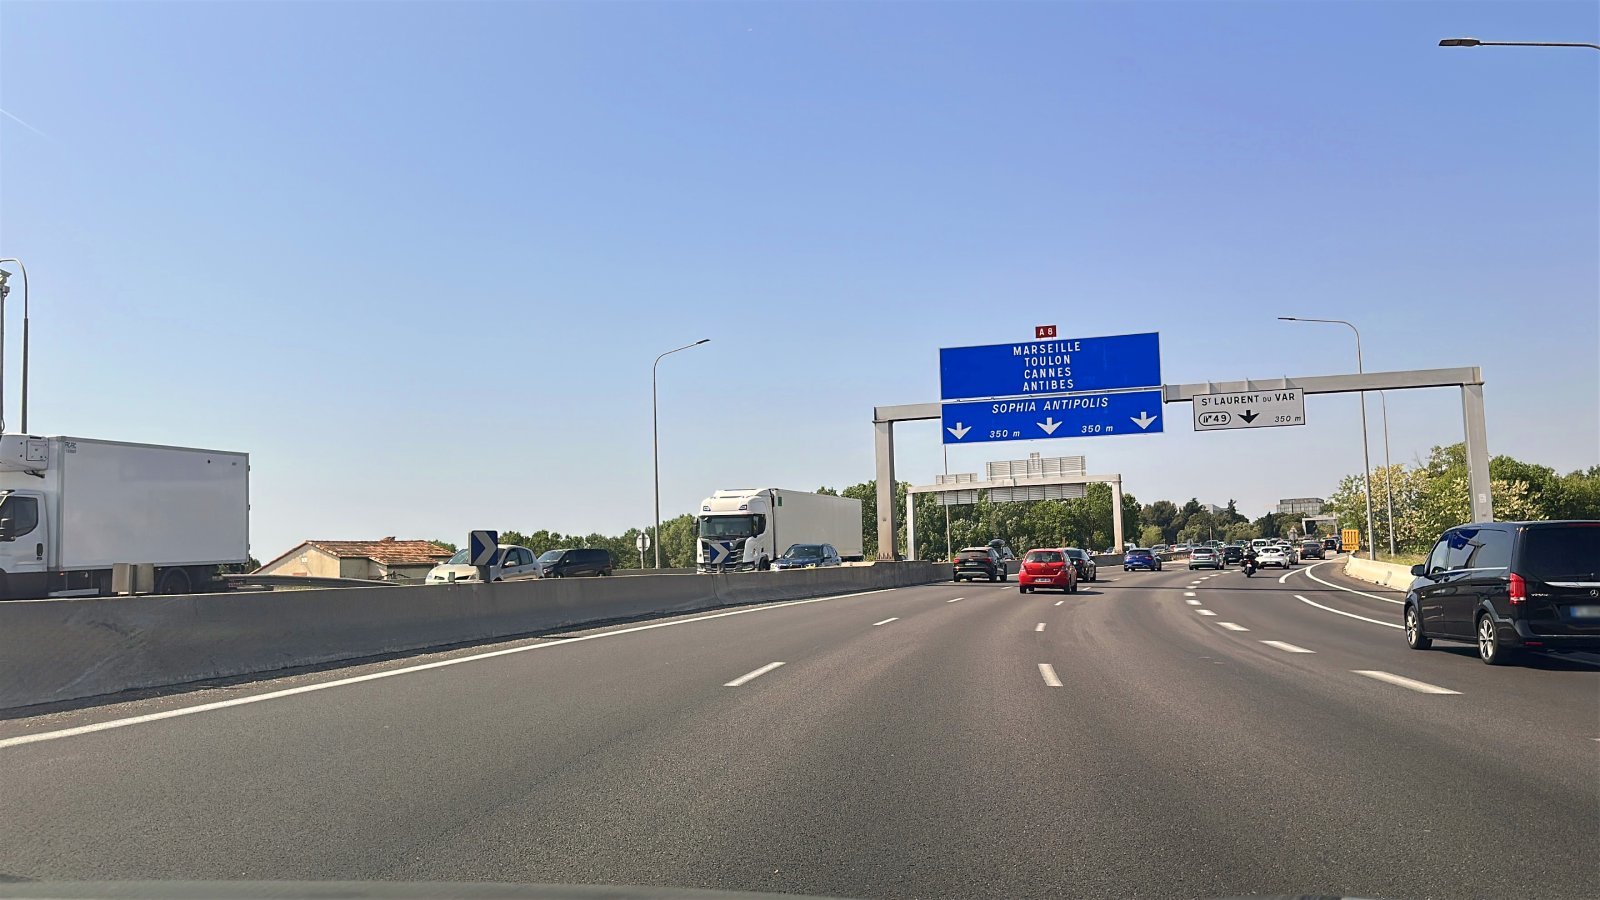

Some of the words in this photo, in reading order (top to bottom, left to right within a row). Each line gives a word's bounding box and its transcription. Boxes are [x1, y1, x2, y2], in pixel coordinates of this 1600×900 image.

[1013, 341, 1081, 356] MARSEILLE
[1024, 355, 1071, 367] TOULON
[1024, 367, 1071, 379] CANNES
[1023, 379, 1074, 391] ANTIBES
[1214, 395, 1259, 405] LAURENT
[1274, 392, 1295, 402] VAR
[992, 401, 1036, 414] SOPHIA
[1043, 397, 1109, 410] ANTIPOLIS
[1274, 415, 1291, 423] 350
[989, 430, 1008, 439] 350
[1081, 424, 1101, 434] 350
